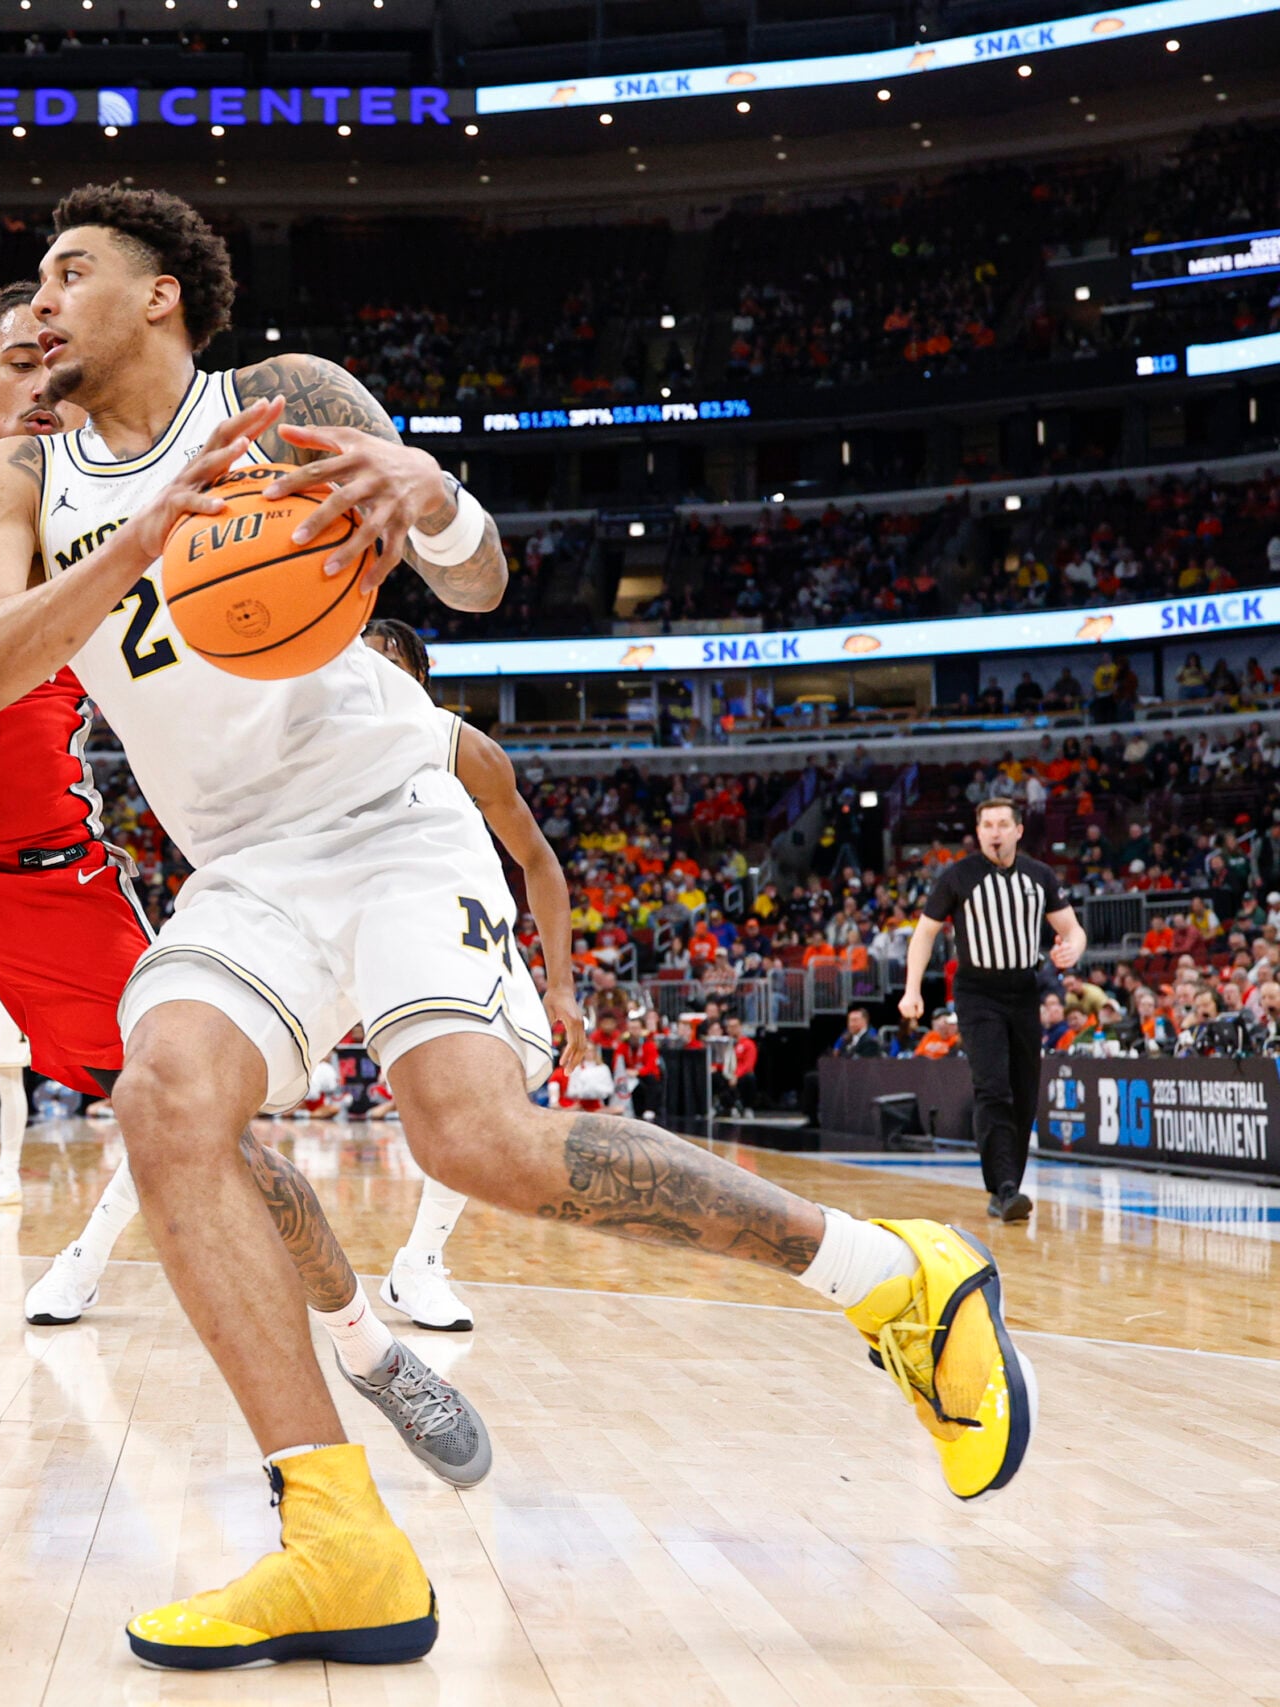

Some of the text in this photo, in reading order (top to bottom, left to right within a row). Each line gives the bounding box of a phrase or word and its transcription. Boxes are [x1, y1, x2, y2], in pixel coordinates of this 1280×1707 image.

[974, 27, 1055, 57] SNACK
[614, 74, 691, 97] SNACK
[158, 86, 451, 126] CENTER
[409, 416, 462, 433] BONUS
[188, 508, 293, 563] EVO NXT
[1161, 596, 1263, 629] SNACK
[702, 637, 799, 662] SNACK
[457, 895, 513, 976] M
[1152, 1079, 1269, 1111] 2026 TIAA BASKETBALL
[1153, 1109, 1269, 1161] TOURNAMENT
